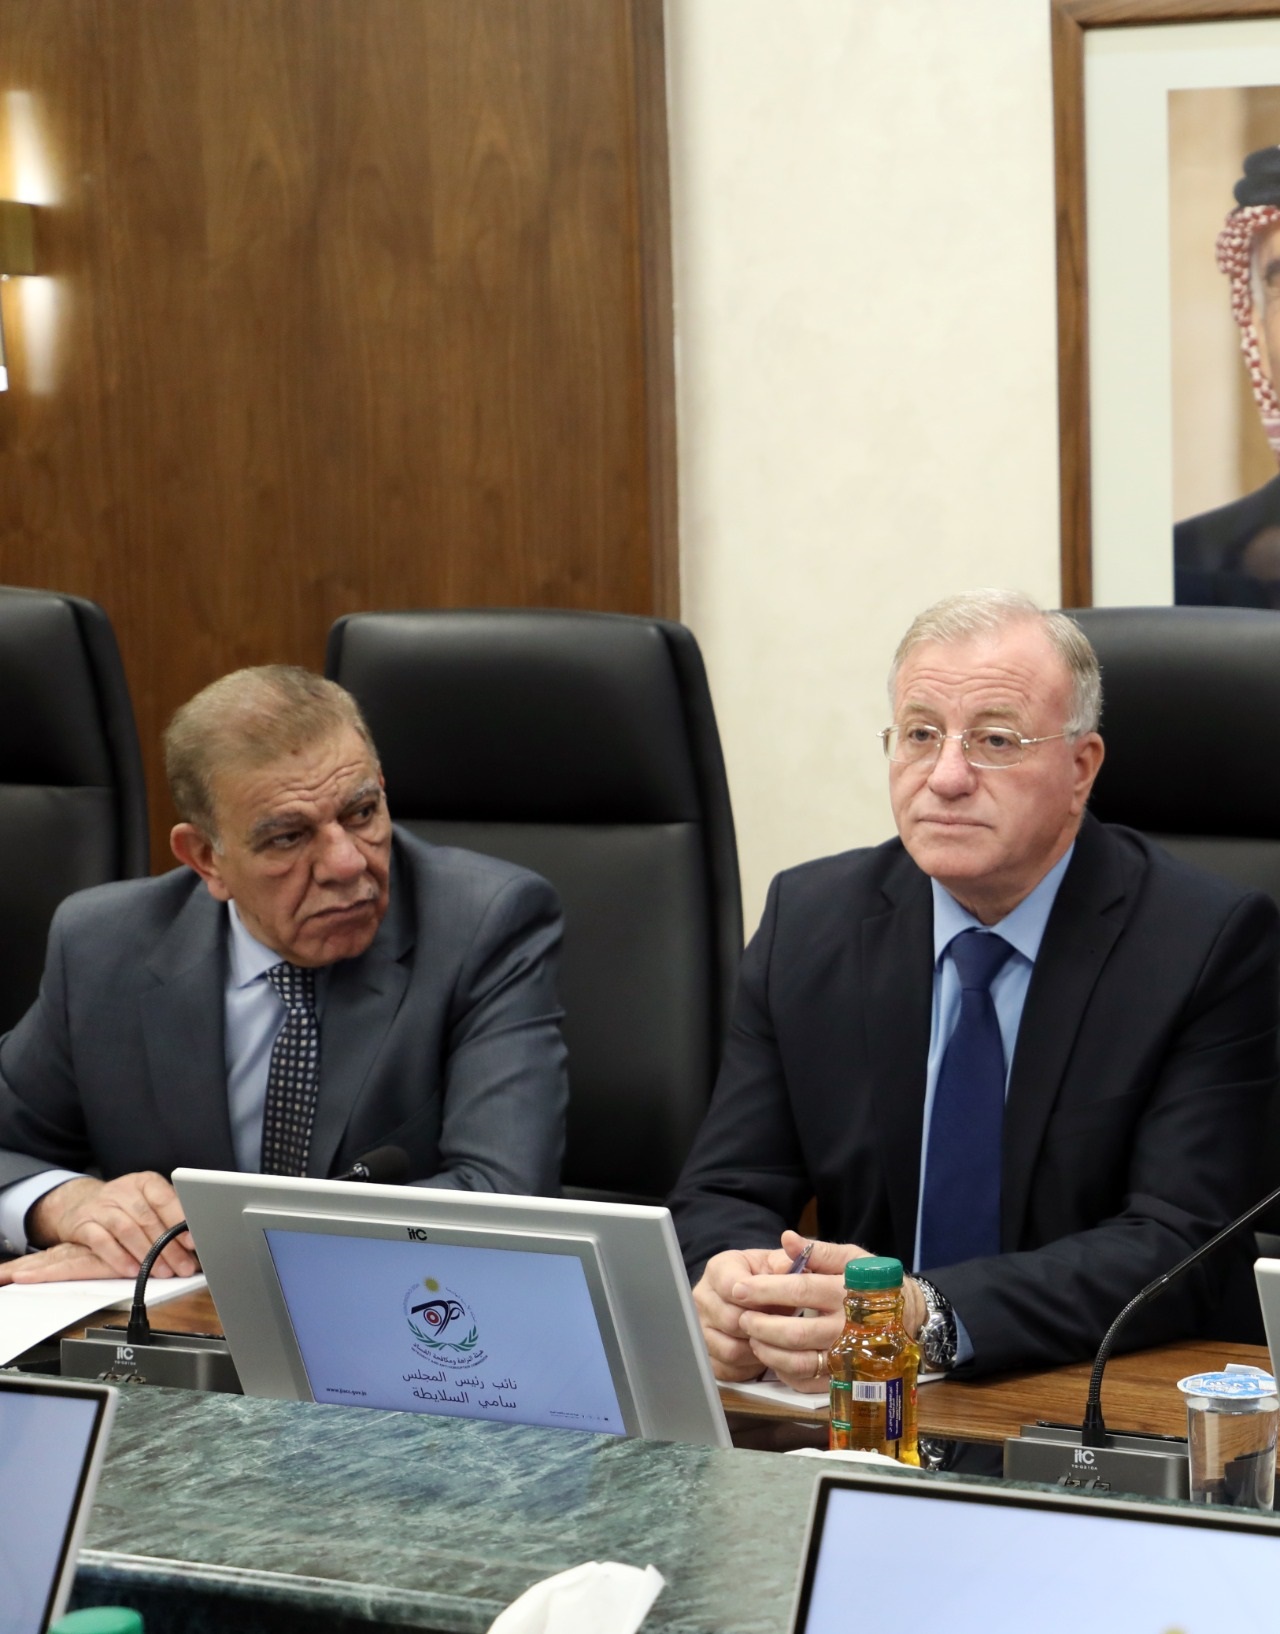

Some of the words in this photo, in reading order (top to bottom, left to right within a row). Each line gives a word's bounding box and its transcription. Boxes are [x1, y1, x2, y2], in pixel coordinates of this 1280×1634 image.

[402, 1369, 447, 1383] المجلس
[455, 1376, 484, 1389] رئيس
[492, 1378, 517, 1390] نائب
[413, 1386, 469, 1404] السلايطة
[479, 1394, 516, 1409] سامي
